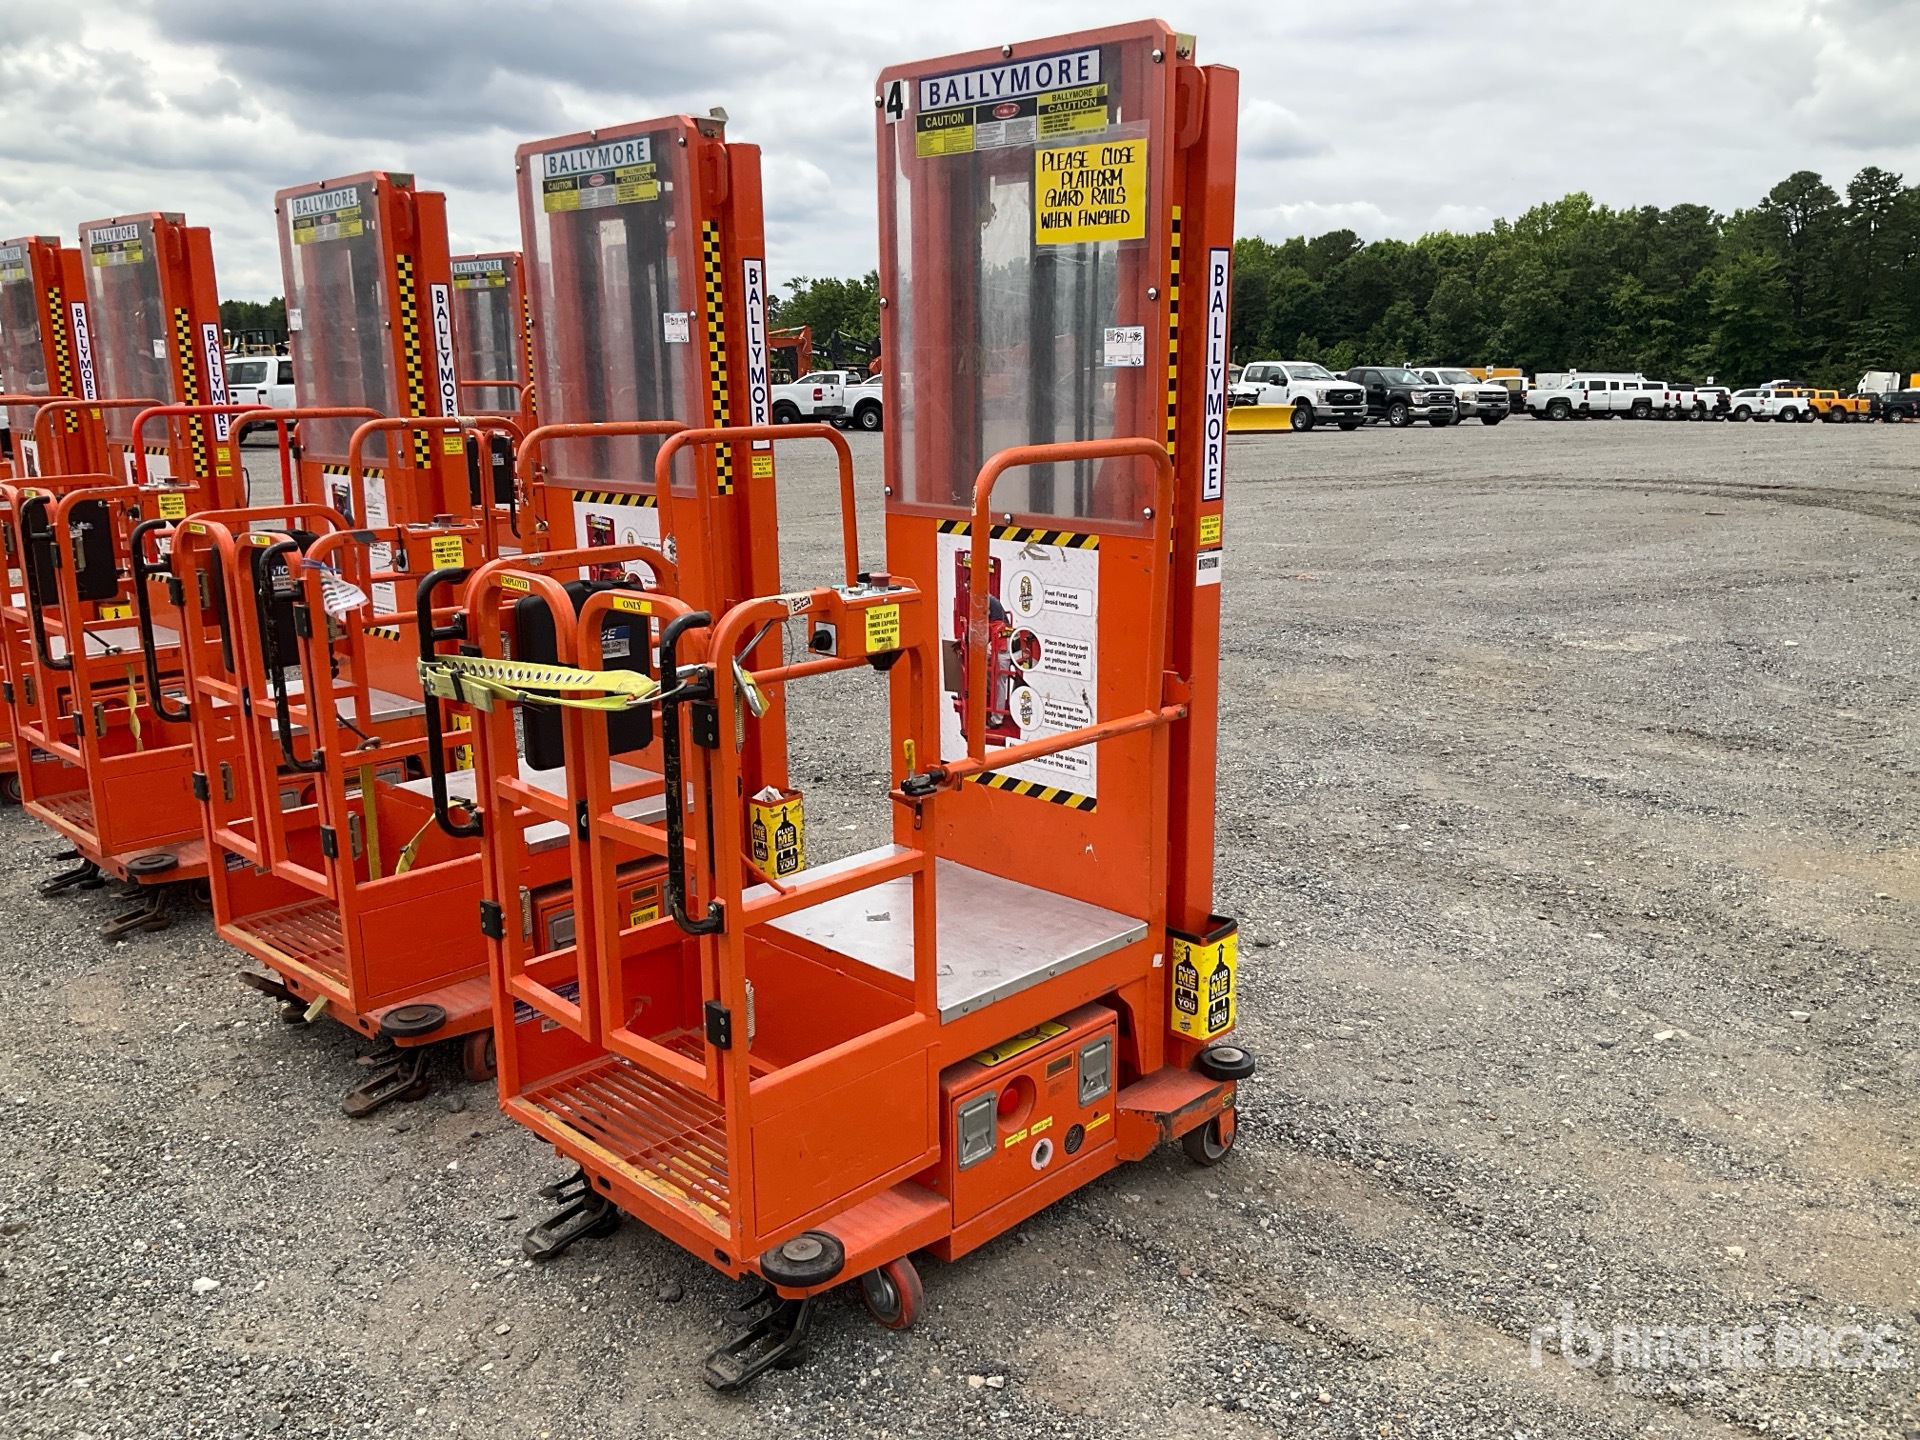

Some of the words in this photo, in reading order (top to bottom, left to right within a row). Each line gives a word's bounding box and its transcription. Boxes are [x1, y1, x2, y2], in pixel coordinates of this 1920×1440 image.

[929, 54, 1090, 107] BALLYMORE
[886, 80, 904, 120] 4
[1051, 88, 1093, 102] BALLYMORE
[1047, 97, 1098, 113] CAUTION
[925, 112, 965, 128] CAUTION
[549, 141, 645, 174] BALLYMORE
[1042, 150, 1090, 172] PLEASE
[1101, 146, 1136, 166] CLOSE
[547, 180, 573, 191] CAUTION
[1061, 167, 1123, 190] PLATFORM
[295, 189, 355, 215] BALLYMORE
[1044, 188, 1085, 208] GUARD
[1090, 186, 1127, 205] RAILS
[1041, 210, 1072, 229] WHEN
[1078, 208, 1130, 227] FINISHED
[92, 225, 137, 243] BALLYMORE
[456, 260, 500, 272] BALLYMORE
[748, 267, 766, 424] BALLYMOR
[75, 308, 94, 399] BALLYMORE
[436, 290, 455, 416] BALLYMOR
[207, 329, 228, 437] BALLYMRE
[1207, 263, 1225, 490] BALLYMORE
[622, 600, 642, 610] ONLY
[869, 612, 883, 621] RESET
[883, 611, 892, 619] LIFT
[869, 629, 881, 637] TURN
[1044, 638, 1058, 647] Place
[1058, 640, 1066, 648] the
[1066, 642, 1079, 651] body
[1054, 649, 1068, 657] static
[1068, 651, 1087, 660] lanyard
[1051, 657, 1068, 665] yellow
[1067, 659, 1080, 667] hook
[1044, 701, 1062, 711] Always
[1044, 709, 1057, 718] body
[1067, 713, 1089, 724] attached
[1050, 718, 1064, 727] static
[1055, 761, 1064, 769] the
[1064, 755, 1076, 763] side
[1076, 758, 1088, 766] rails
[754, 829, 766, 838] ME
[777, 826, 794, 837] PLUG
[777, 832, 794, 845] ME
[755, 849, 767, 857] YOU
[780, 859, 796, 870] YOU
[1178, 964, 1197, 976] PLUG
[1211, 968, 1228, 983] PLUG
[1178, 971, 1196, 984] ME
[1211, 977, 1228, 995] ME
[1177, 997, 1196, 1011] YOU
[1210, 1010, 1228, 1026] YOU
